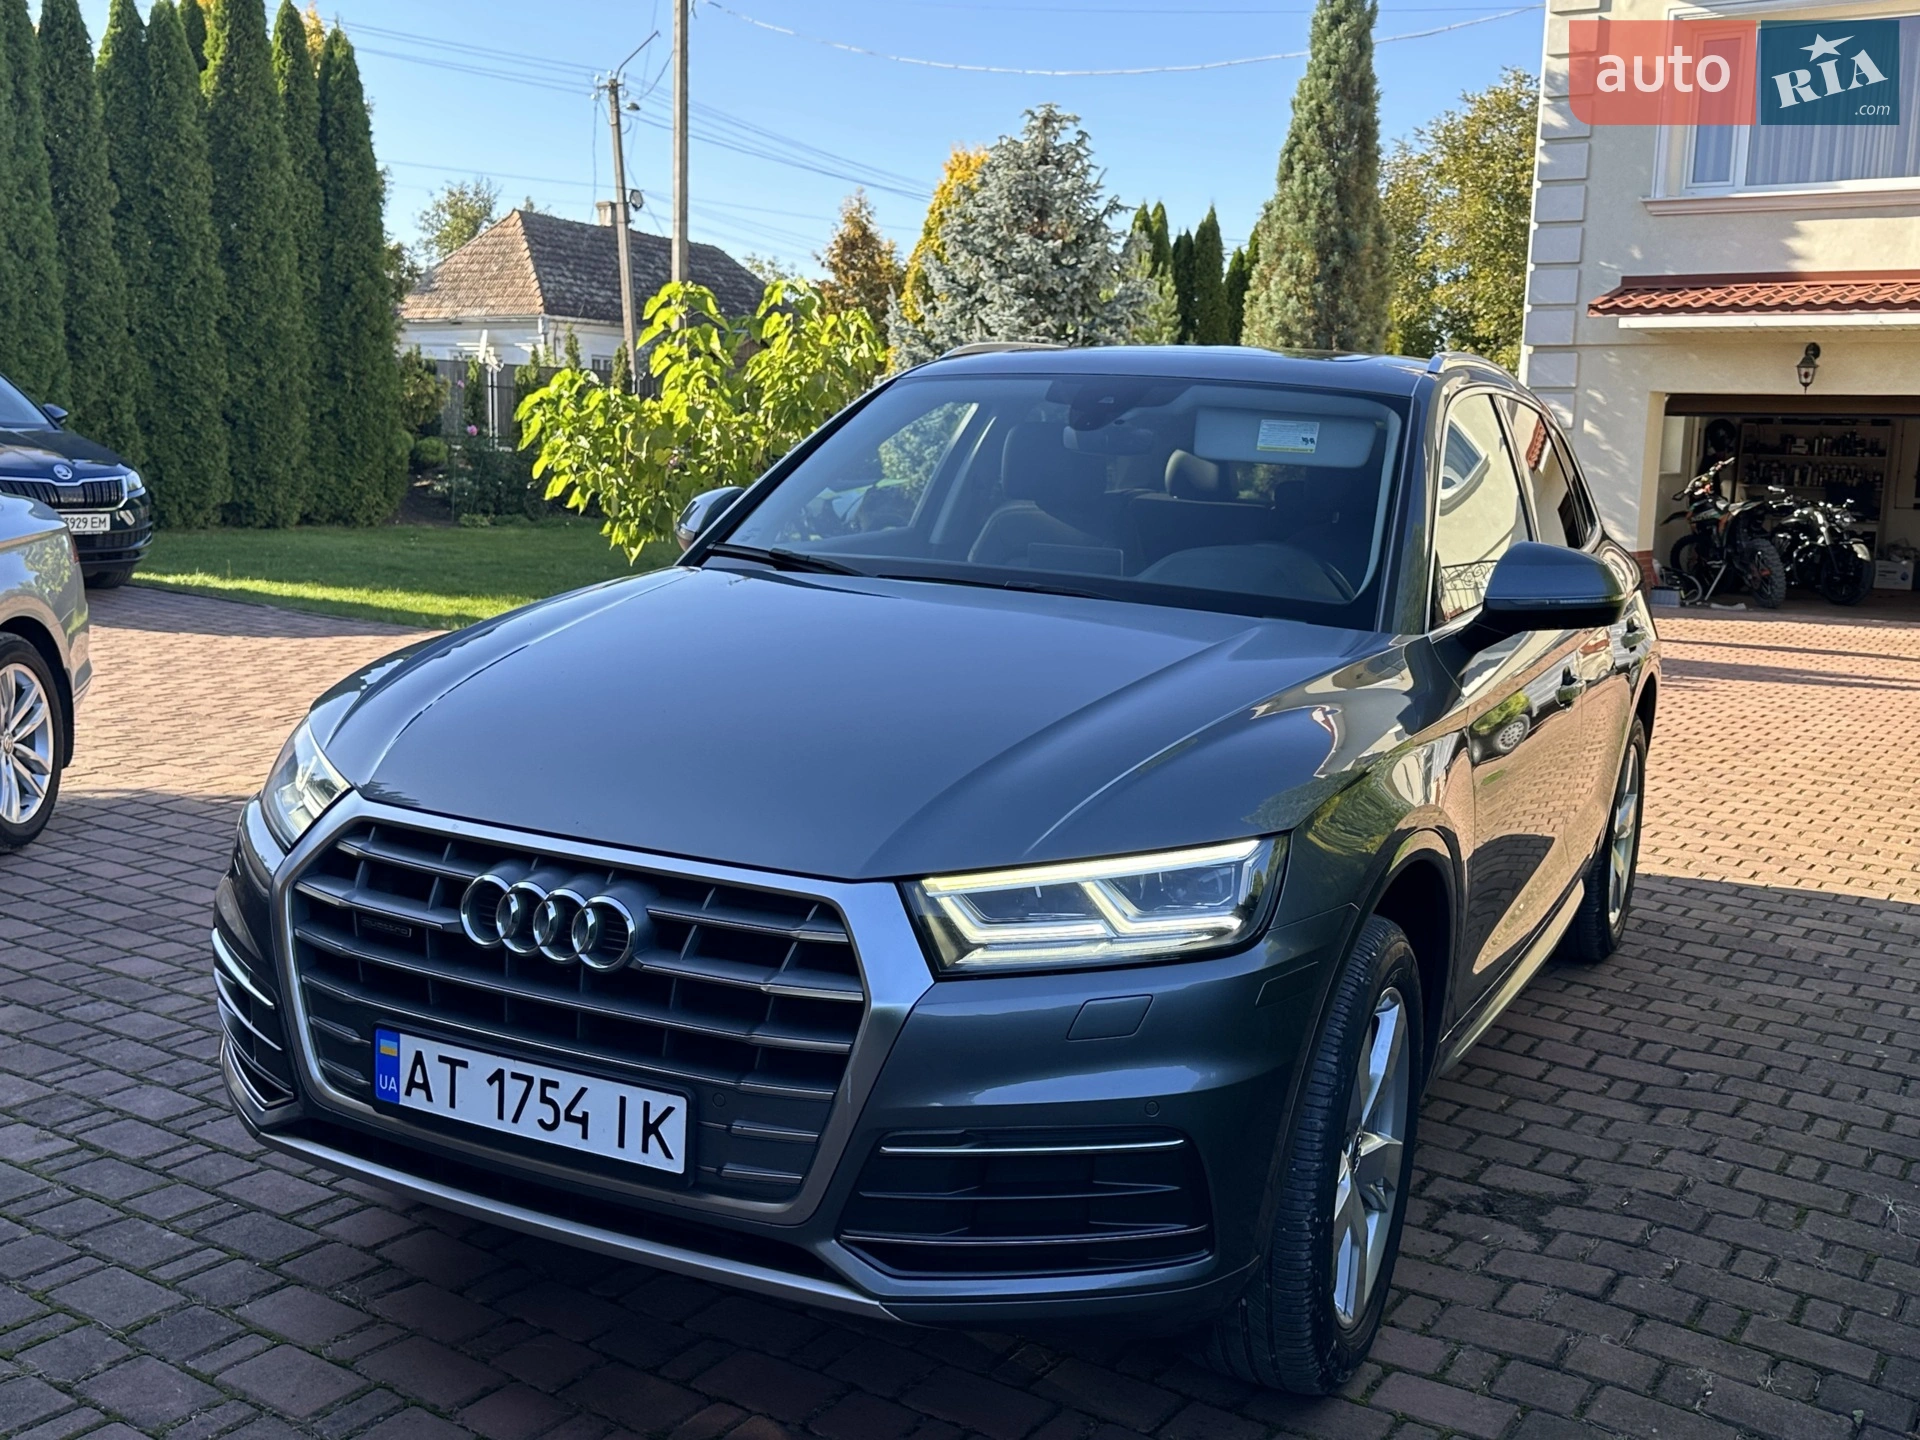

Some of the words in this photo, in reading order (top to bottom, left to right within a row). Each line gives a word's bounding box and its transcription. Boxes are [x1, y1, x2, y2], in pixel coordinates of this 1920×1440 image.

[90, 517, 107, 528] EM
[379, 1074, 398, 1094] UA
[404, 1050, 469, 1110] AT
[486, 1068, 589, 1141] 1754
[617, 1095, 676, 1160] IK
